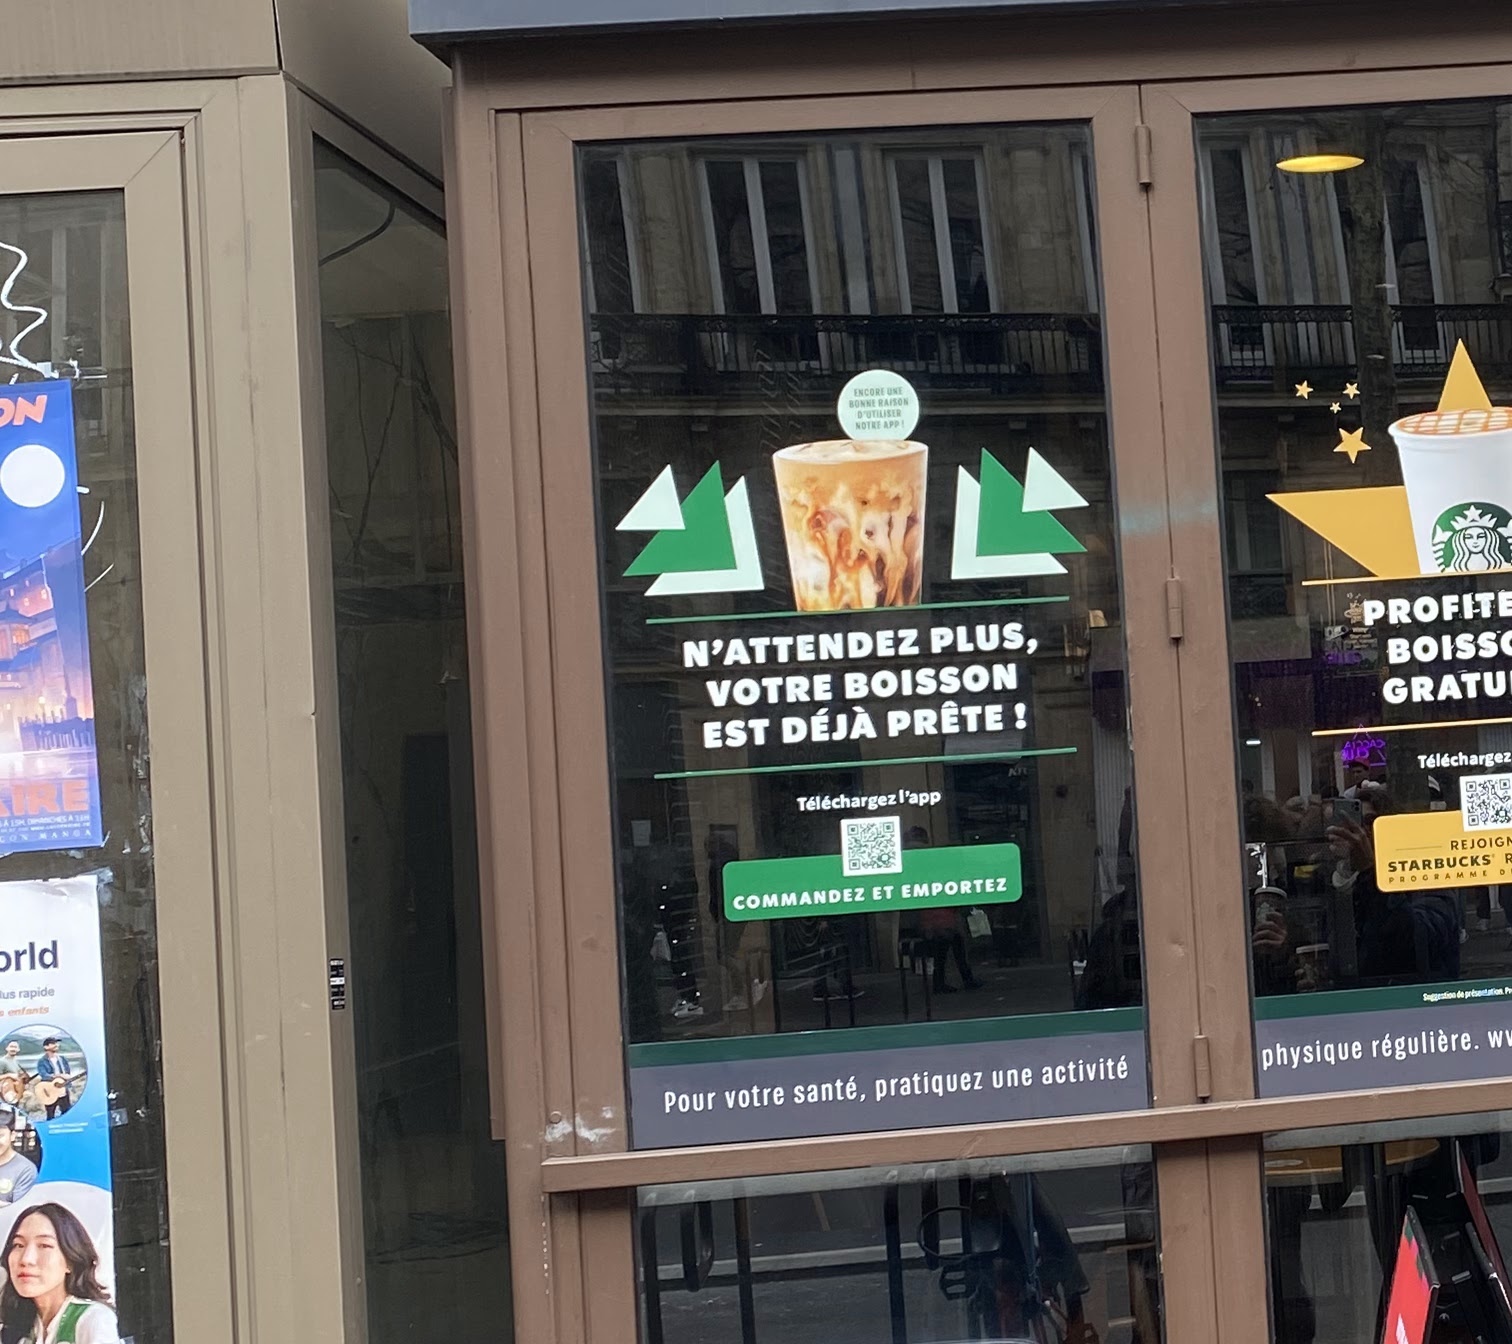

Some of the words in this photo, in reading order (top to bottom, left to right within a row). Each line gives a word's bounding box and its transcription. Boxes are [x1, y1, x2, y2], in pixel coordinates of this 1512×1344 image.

[854, 388, 885, 396] ENCORE
[887, 387, 903, 395] UNE
[849, 399, 876, 408] BONNE
[878, 397, 909, 407] RAISON
[855, 421, 881, 430] NOTRE
[883, 421, 900, 429] APP
[683, 628, 920, 668] N'ATTENDEZ
[931, 622, 1039, 656] PLUS,
[706, 672, 832, 707] VOTRE
[845, 662, 1018, 700] BOISSON
[703, 717, 769, 748] EST
[782, 705, 876, 744] DÉJÀ
[888, 700, 1003, 734] PRÊTE
[1417, 750, 1511, 769] Téléchargez
[796, 793, 897, 813] Téléchargez
[1388, 869, 1488, 884] PROGRAMME
[733, 885, 866, 910] COMMANDEZ
[872, 884, 896, 900] ET
[901, 876, 1008, 898] EMPORTEZ
[18, 987, 55, 1001] rapide
[1261, 1040, 1364, 1071] physique
[1371, 1029, 1480, 1061] régulière.
[664, 1089, 717, 1114] Pour
[724, 1085, 785, 1110] votre
[793, 1077, 867, 1105] santé,
[874, 1072, 984, 1102] pratiquez
[991, 1066, 1033, 1090] une
[1041, 1055, 1130, 1086] activité
